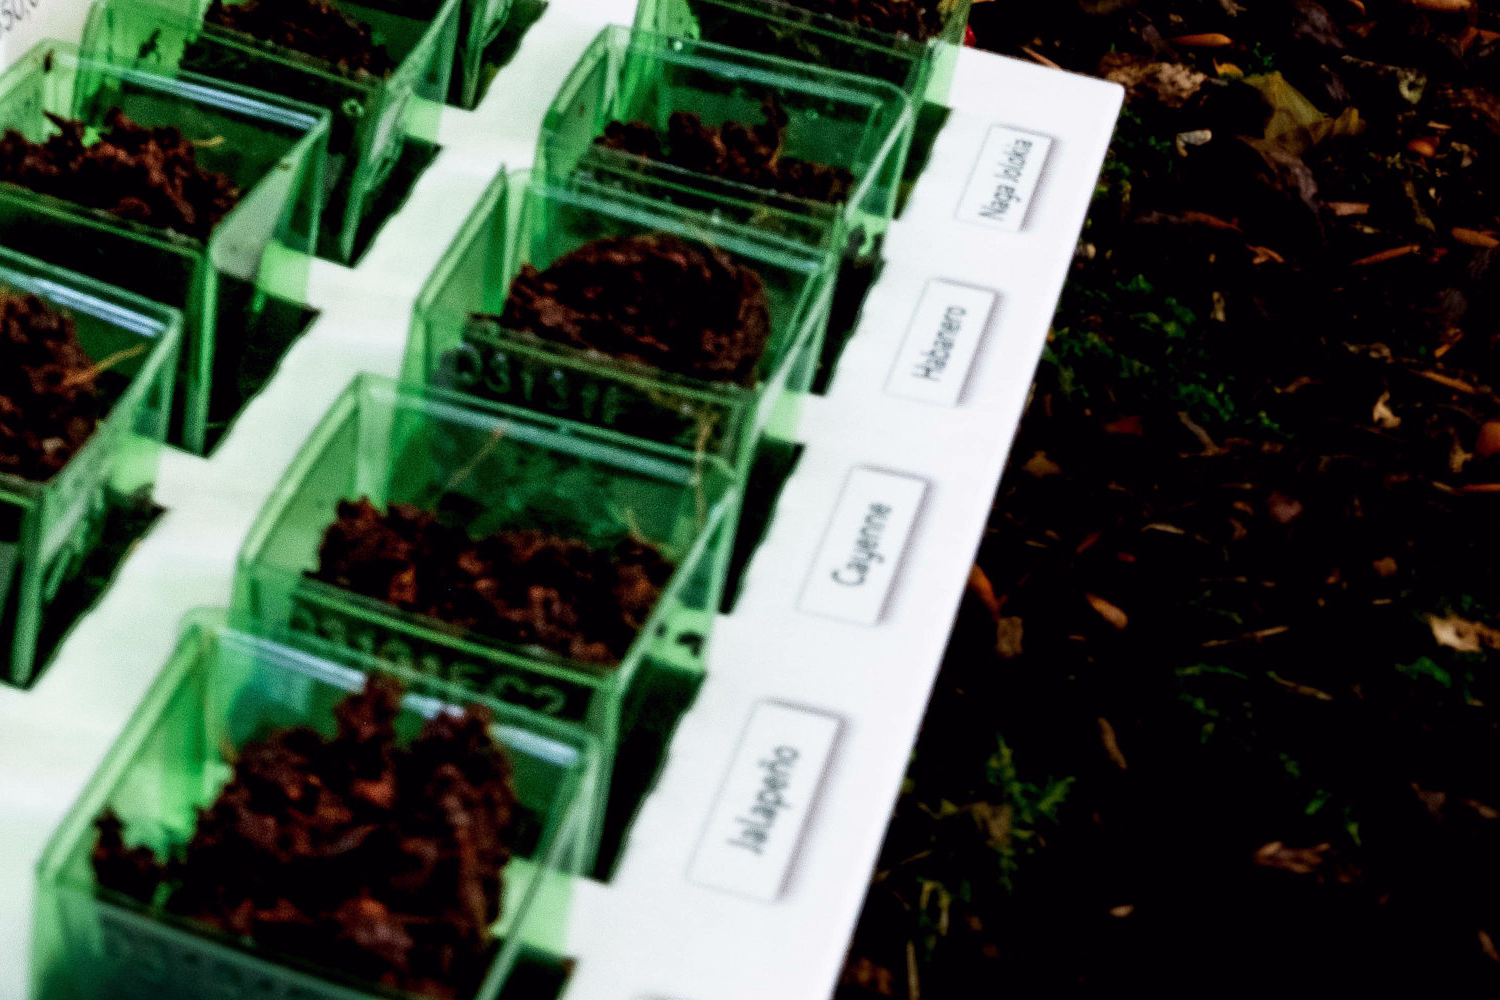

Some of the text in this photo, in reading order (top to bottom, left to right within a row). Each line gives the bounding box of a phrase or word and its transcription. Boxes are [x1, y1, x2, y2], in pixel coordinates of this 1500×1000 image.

[979, 184, 1021, 222] Naga
[911, 304, 968, 382] Habanero
[830, 503, 894, 588] Cayenne
[725, 744, 801, 857] Jalapeño
